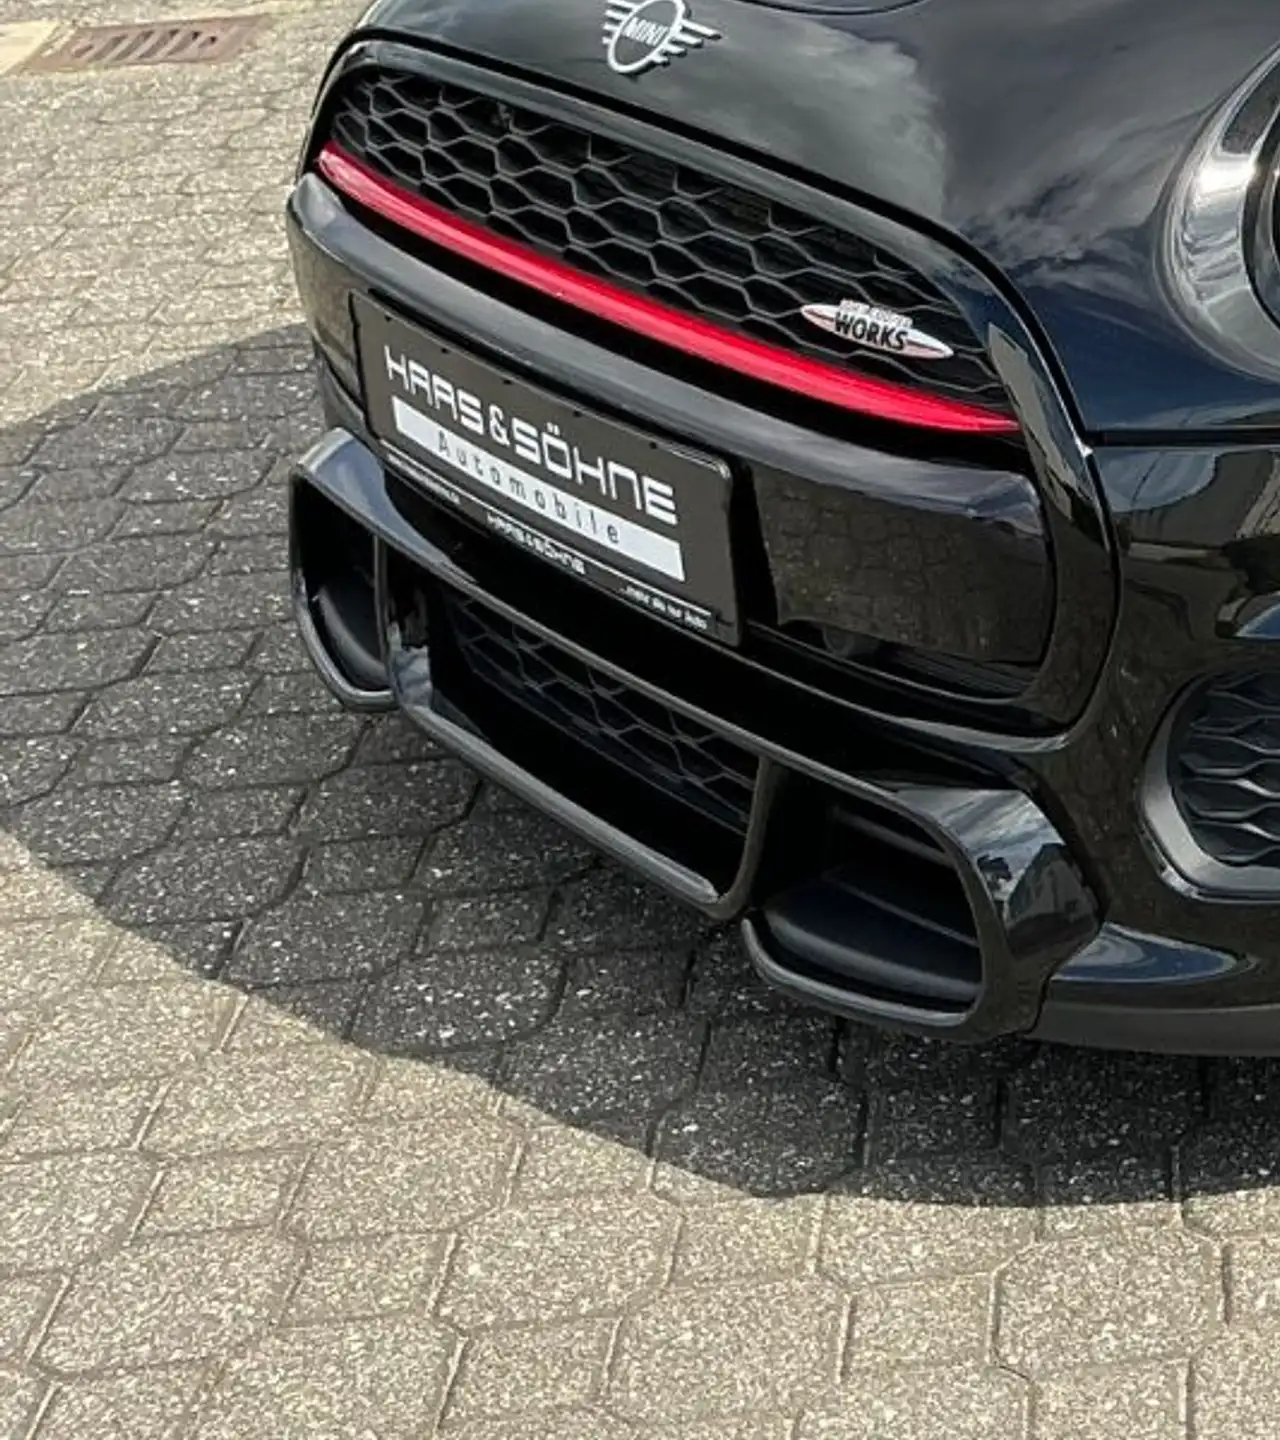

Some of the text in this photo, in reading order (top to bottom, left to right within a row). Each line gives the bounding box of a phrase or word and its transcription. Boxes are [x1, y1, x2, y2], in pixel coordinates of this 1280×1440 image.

[622, 16, 670, 47] MINI
[835, 310, 909, 351] WORKS
[437, 430, 620, 545] Automobile
